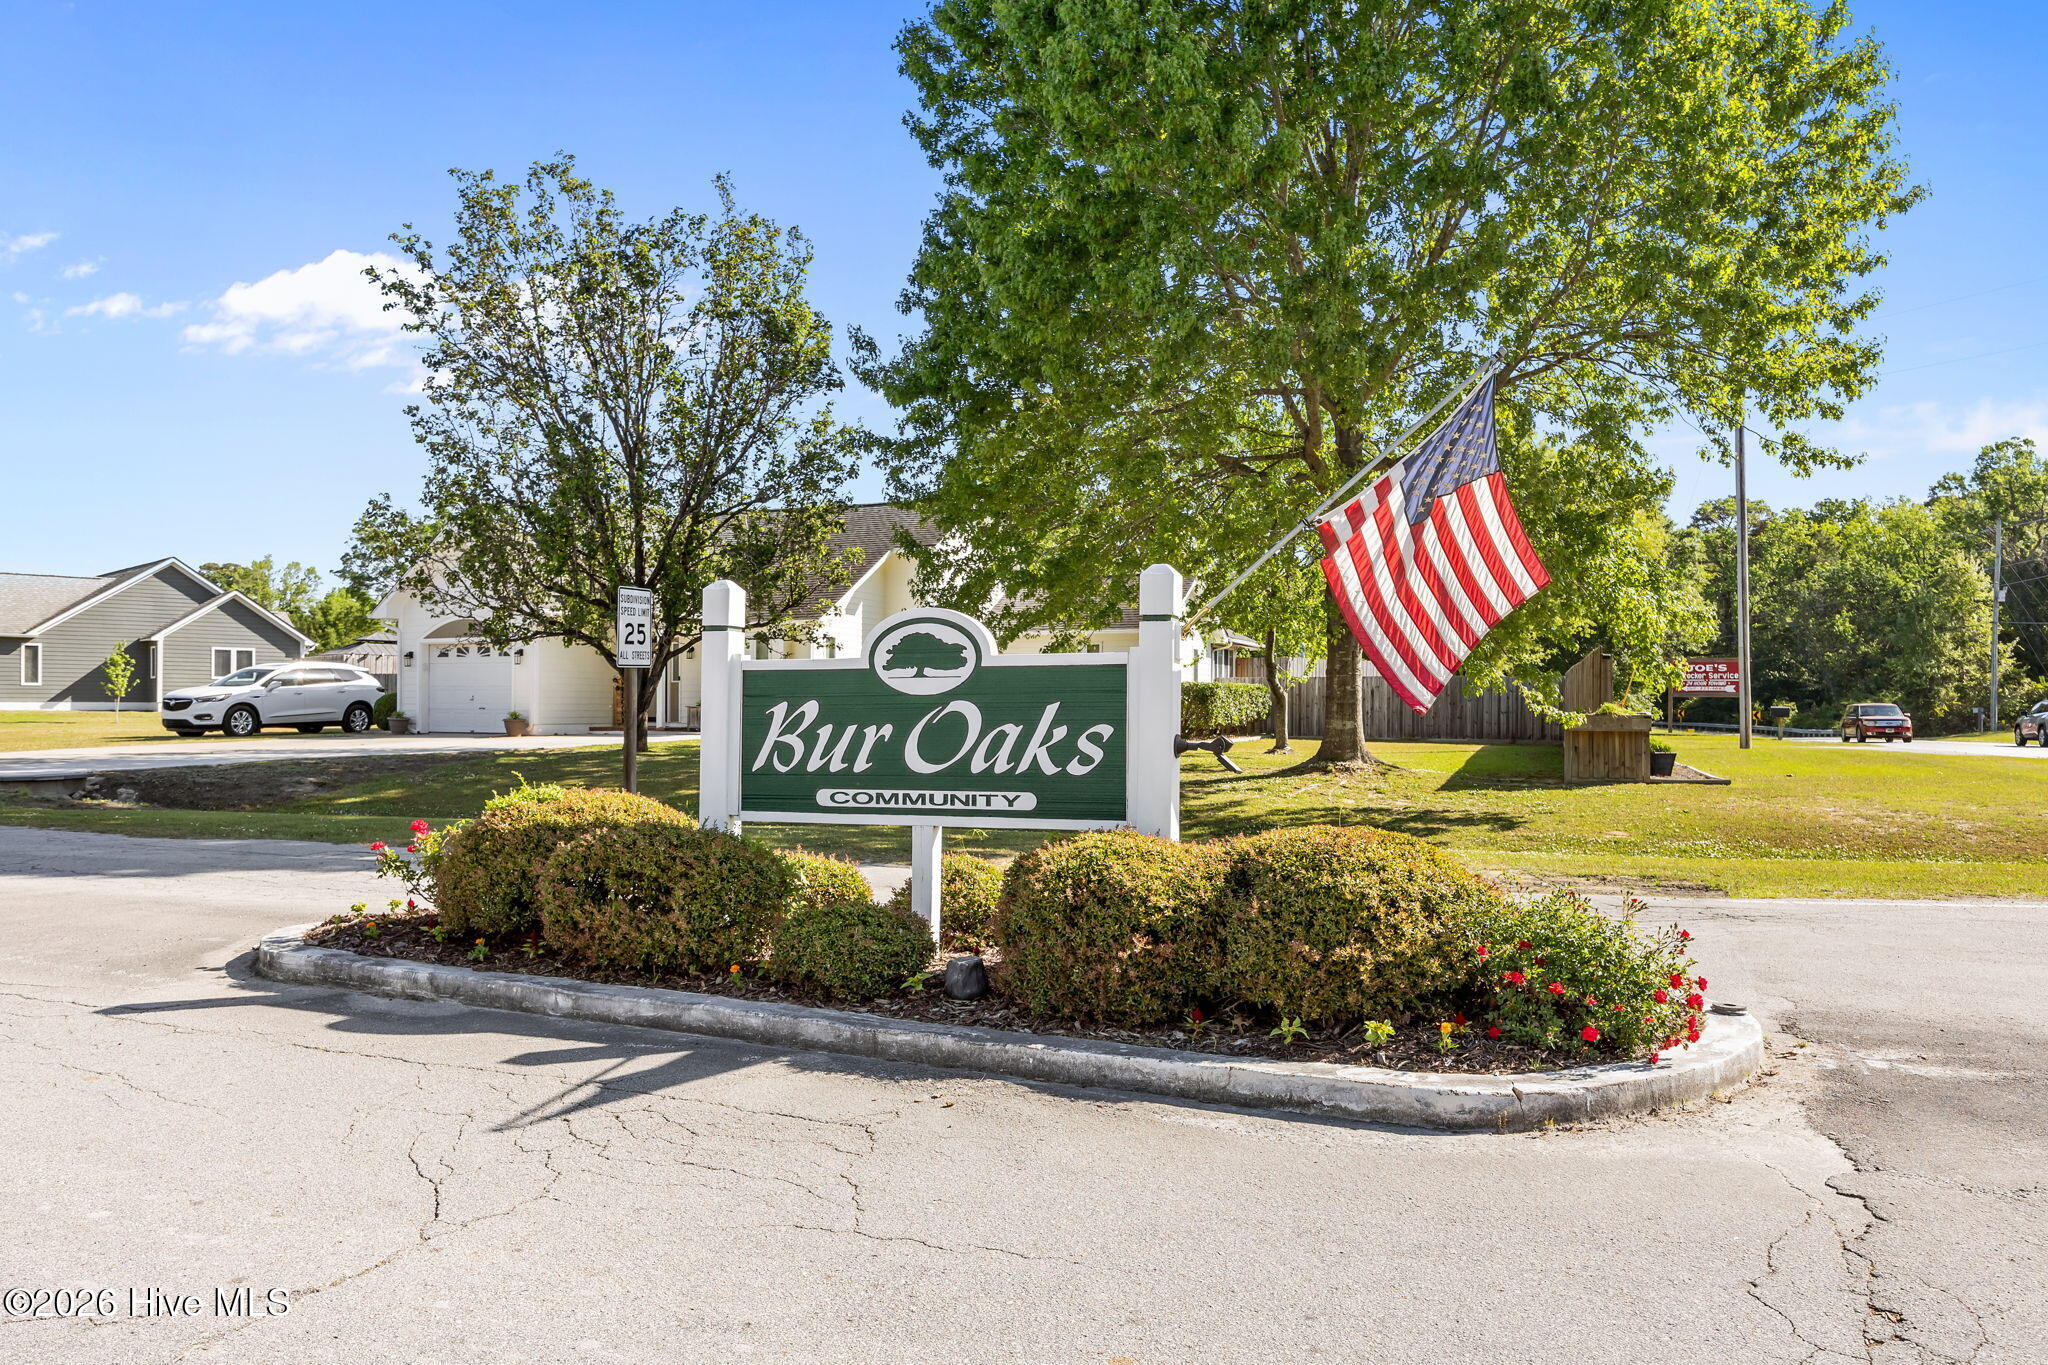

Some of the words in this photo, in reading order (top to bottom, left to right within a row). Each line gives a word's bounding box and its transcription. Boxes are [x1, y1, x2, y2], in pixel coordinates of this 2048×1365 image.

[620, 594, 650, 605] SUBDIVISION
[621, 607, 636, 616] SPEED
[638, 608, 650, 617] LIMIT
[624, 623, 646, 645] 25
[620, 651, 629, 660] ALL
[632, 651, 650, 660] STREETS
[1688, 664, 1728, 672] JOE'S
[752, 699, 894, 774] Bur
[904, 699, 1115, 776] Oaks
[829, 791, 1022, 808] COMMUNITY
